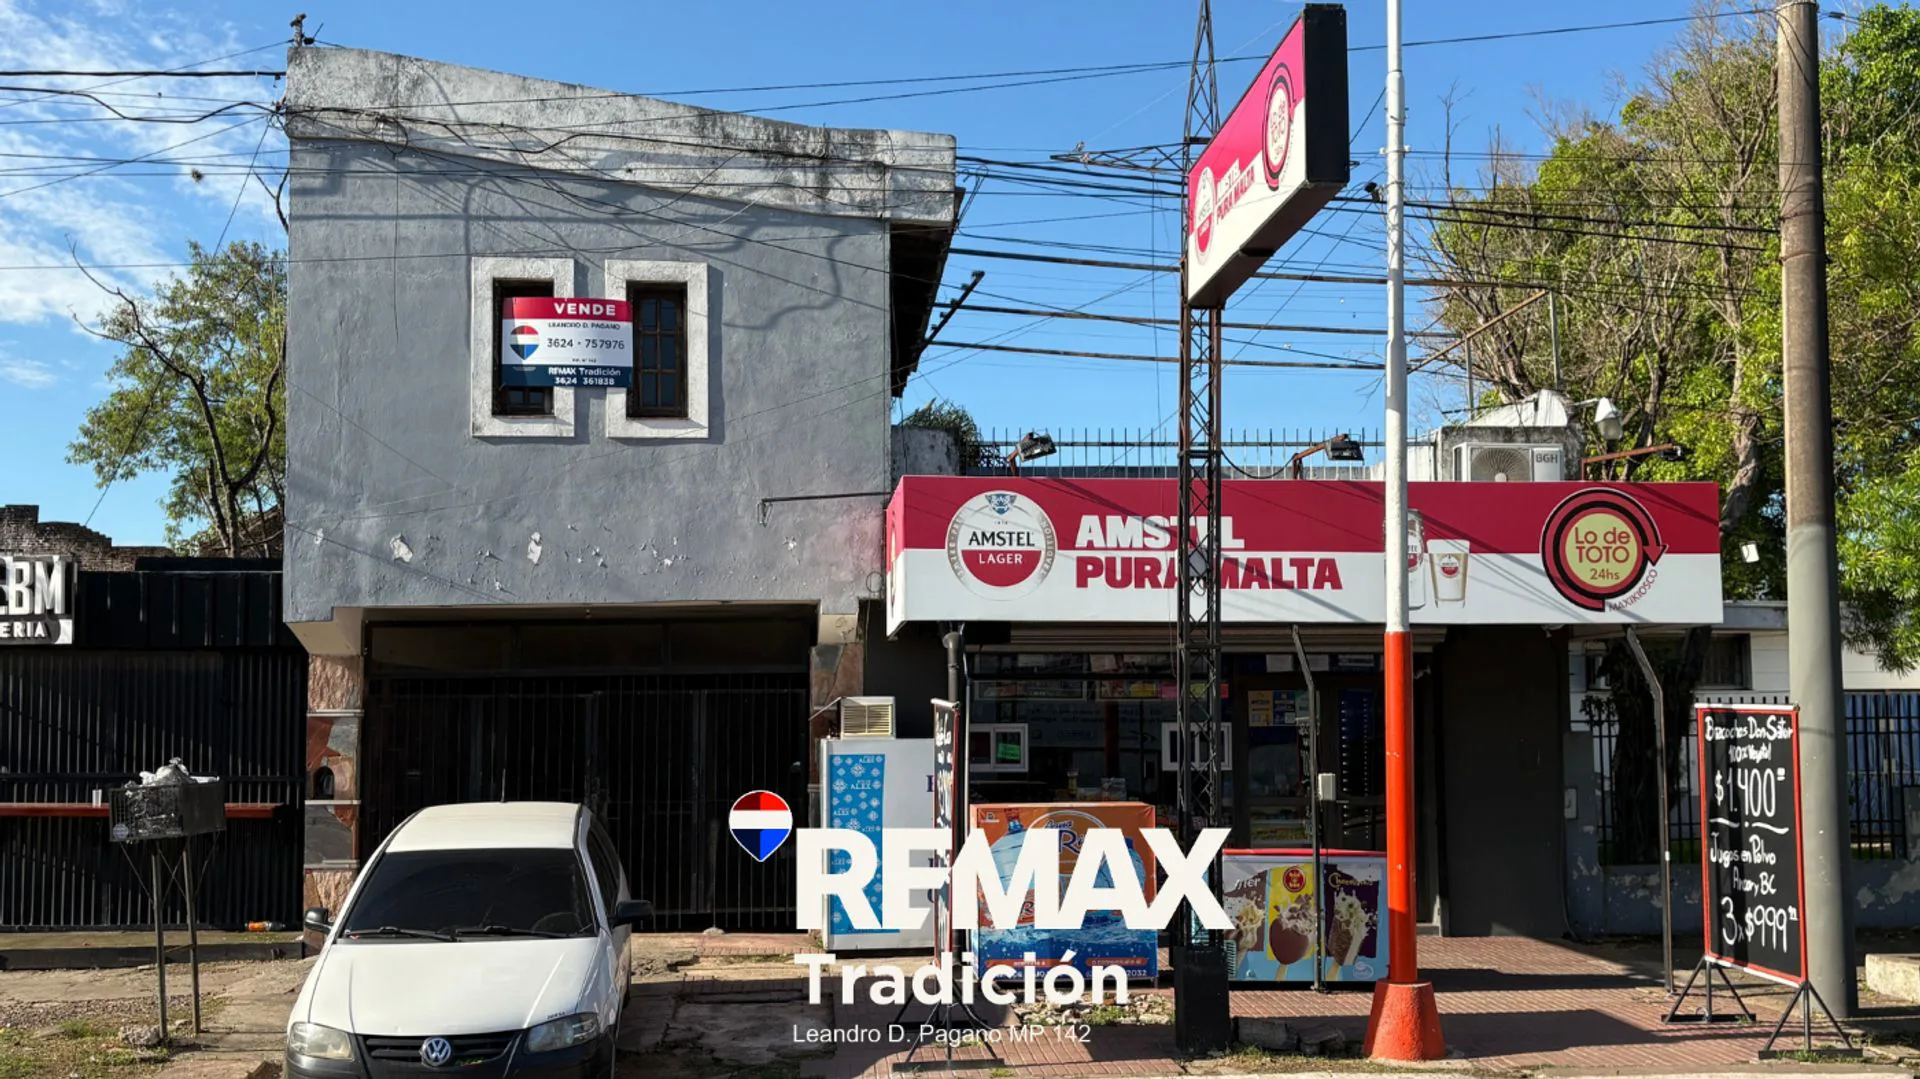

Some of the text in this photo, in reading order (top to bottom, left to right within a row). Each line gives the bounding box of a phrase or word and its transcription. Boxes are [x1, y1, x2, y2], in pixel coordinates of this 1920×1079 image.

[554, 303, 616, 316] VENDE
[547, 338, 574, 348] 3624
[584, 338, 625, 350] 757976
[579, 367, 621, 377] Tradición
[1536, 453, 1558, 464] BGH
[968, 530, 1035, 547] AMSTEL
[1575, 526, 1631, 545] Lo de
[979, 552, 1023, 565] LAGER
[1575, 545, 1630, 564] TOTO
[1589, 568, 1620, 581] 24hs
[1609, 568, 1658, 612] MAXIKIOSCO
